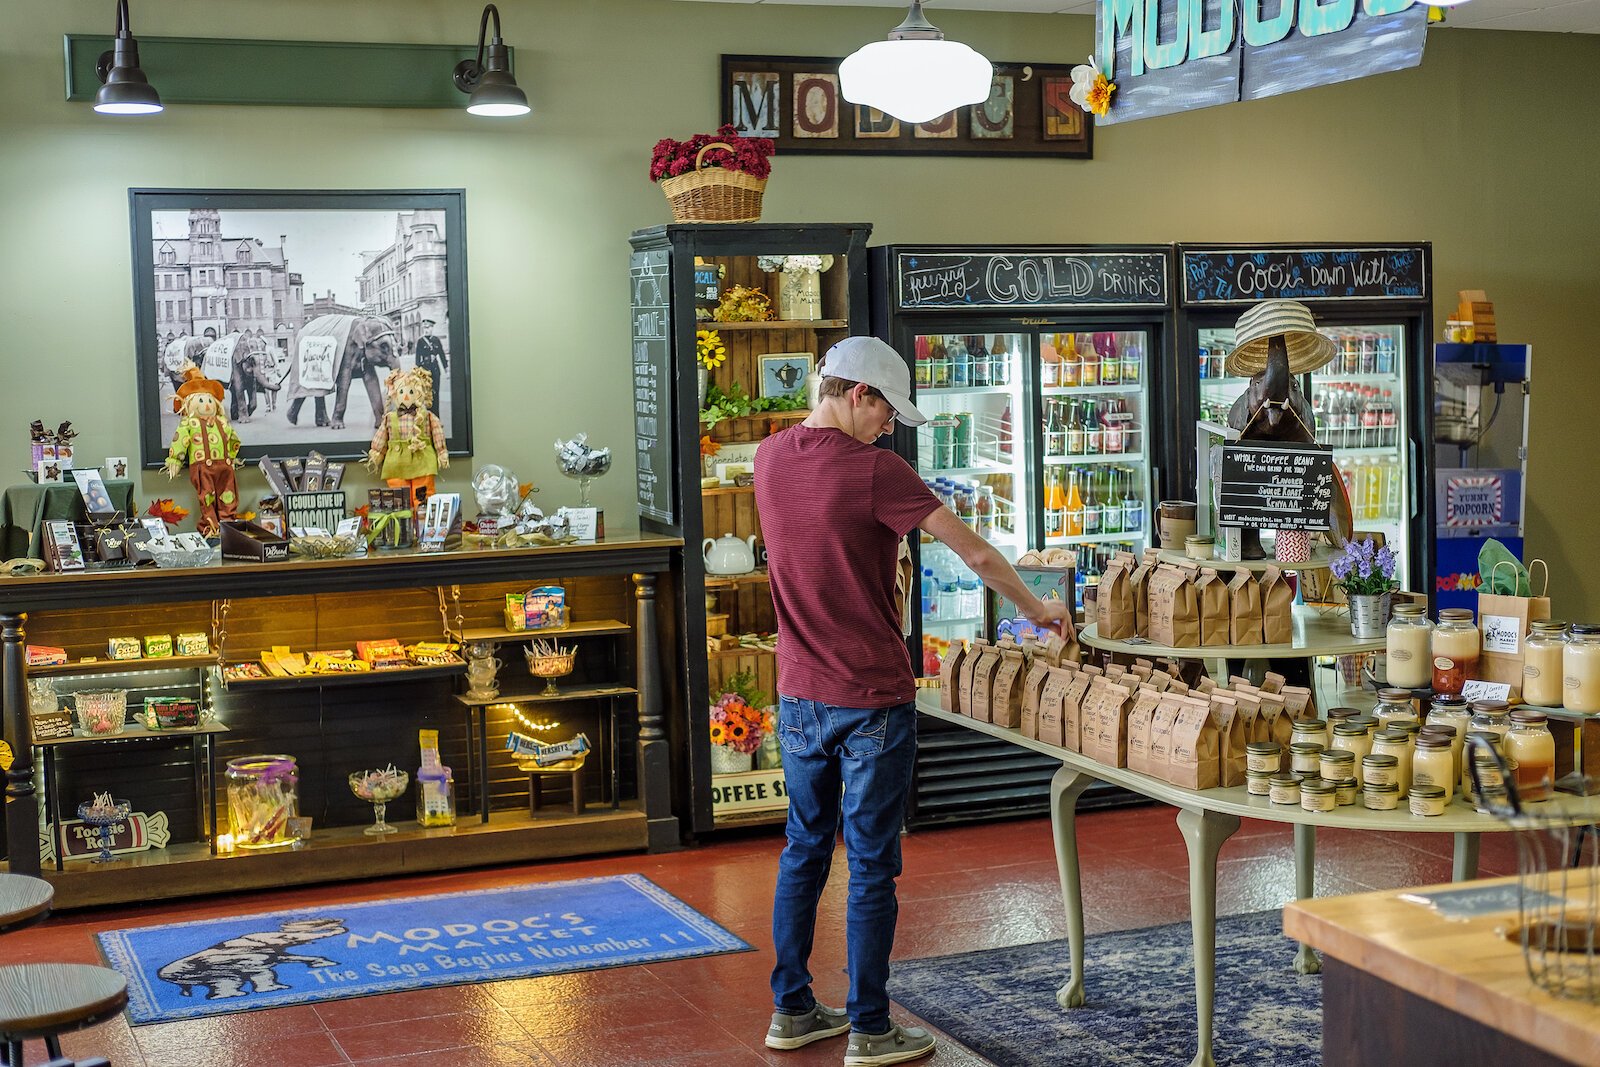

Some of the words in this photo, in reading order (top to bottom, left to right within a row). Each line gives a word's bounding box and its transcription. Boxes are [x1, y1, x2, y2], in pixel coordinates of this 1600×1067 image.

[735, 66, 1081, 136] MOC'S
[905, 262, 977, 303] freezing
[985, 256, 1094, 303] COLD
[1100, 270, 1161, 296] DRINKS
[1189, 261, 1209, 282] POP
[1215, 276, 1234, 299] TEA
[1234, 453, 1256, 463] WHOLE
[1261, 454, 1289, 466] COFFEE
[1293, 455, 1315, 466] BEANS
[292, 494, 316, 509] COULD
[317, 493, 334, 508] GIVE
[334, 493, 345, 507] UP
[1459, 493, 1489, 502] YUMMY
[1453, 503, 1495, 515] POPCORN
[117, 644, 139, 657] Extra
[149, 642, 171, 654] Extra
[187, 641, 209, 652] Extra
[541, 743, 569, 755] HERSHEY'S
[73, 822, 126, 839] Toosie
[84, 834, 116, 850] Rol
[346, 911, 586, 949] MODOC'S
[398, 926, 599, 956] MARKET
[312, 966, 358, 985] The
[366, 960, 431, 979] Saga
[433, 950, 523, 971] Begins
[527, 935, 650, 960] November
